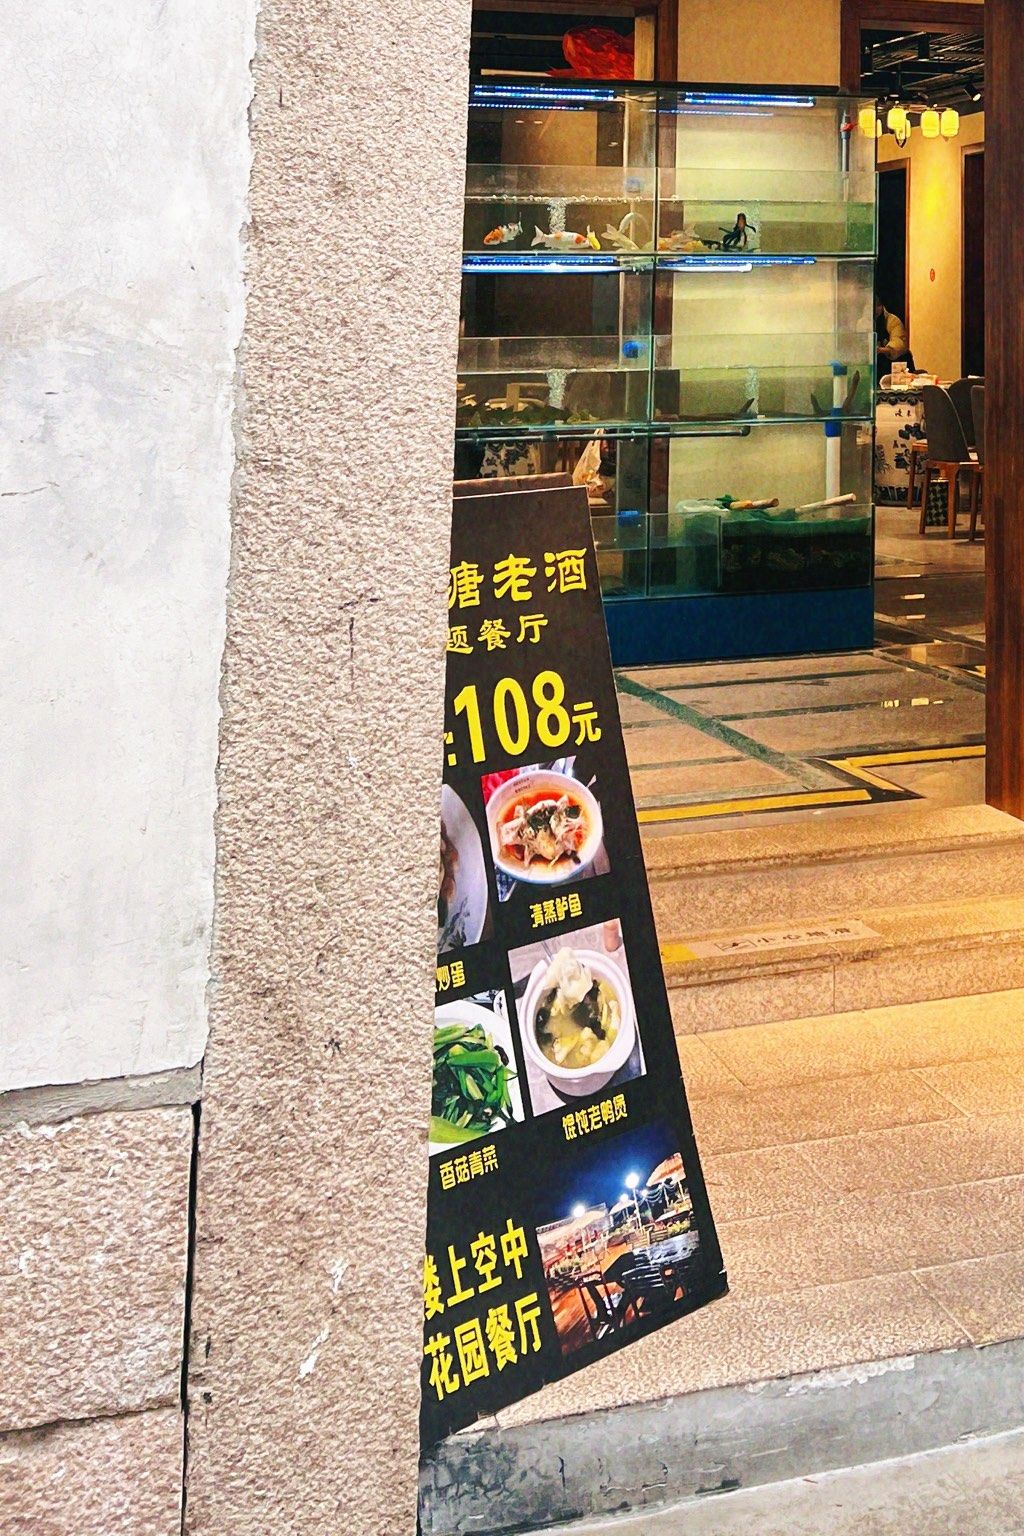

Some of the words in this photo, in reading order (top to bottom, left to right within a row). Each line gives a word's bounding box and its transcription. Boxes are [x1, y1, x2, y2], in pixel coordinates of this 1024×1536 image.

[443, 670, 602, 767] :108元
[529, 893, 583, 928] 清蒸鲈鱼
[562, 1093, 628, 1141] 馄饨老鸭煲
[439, 1144, 499, 1191] 香菇青菜
[423, 1292, 541, 1401] 花园餐厅
